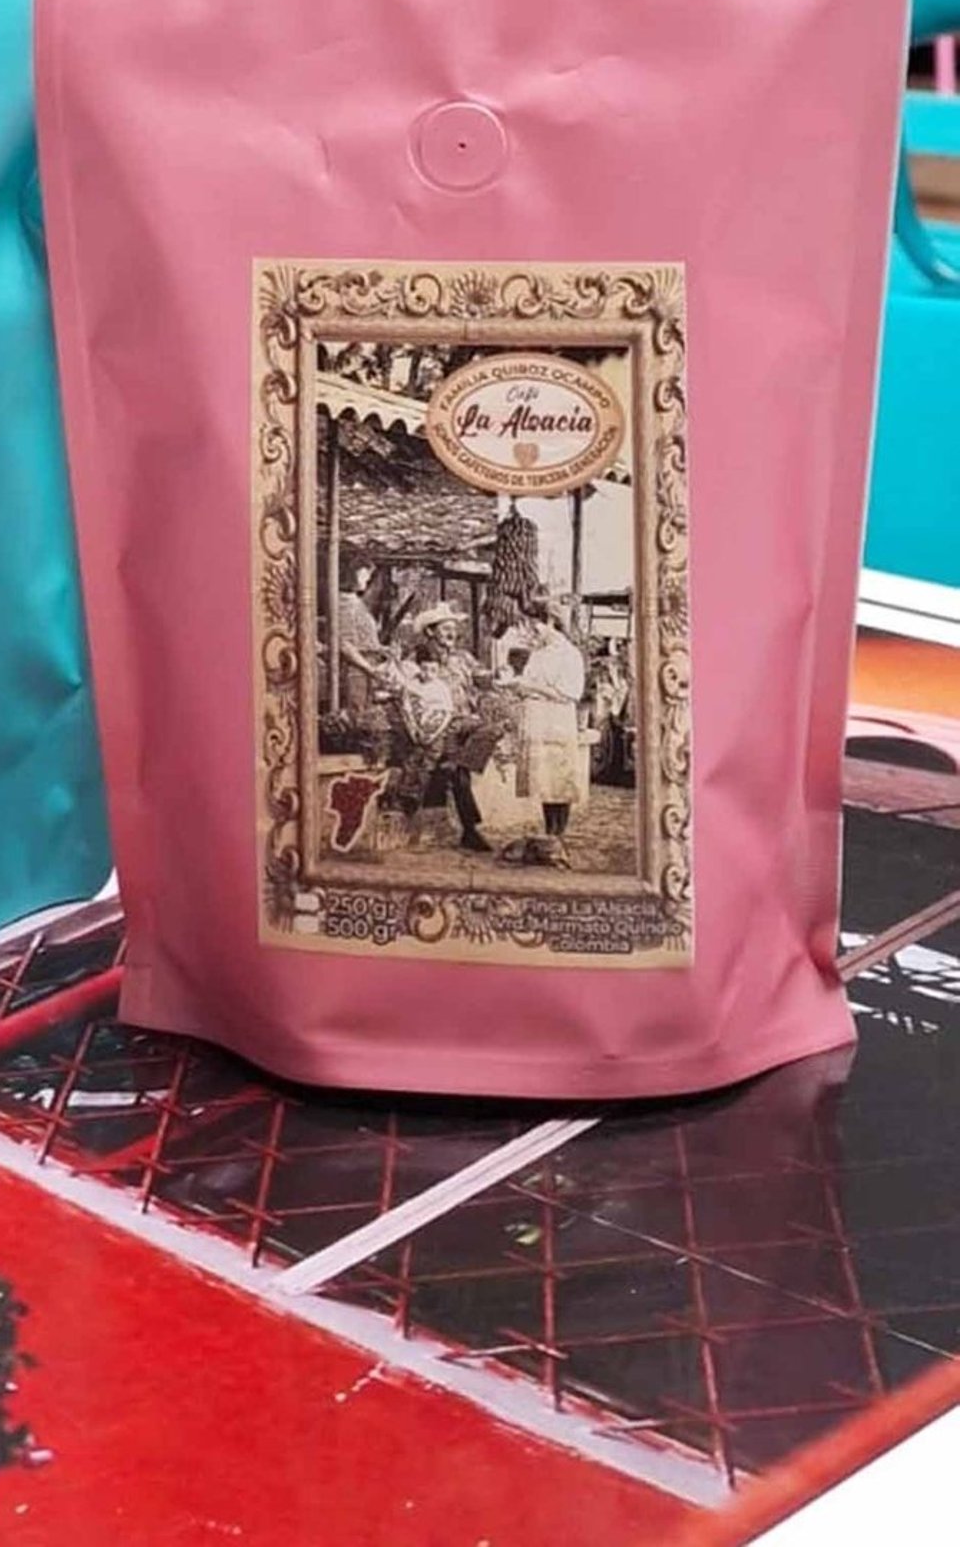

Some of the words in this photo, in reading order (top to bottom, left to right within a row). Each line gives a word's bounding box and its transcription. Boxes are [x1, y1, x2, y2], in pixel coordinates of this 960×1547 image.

[456, 404, 490, 438] La
[497, 405, 592, 439] Alsacia
[327, 894, 368, 916] 250
[327, 916, 369, 938] 500
